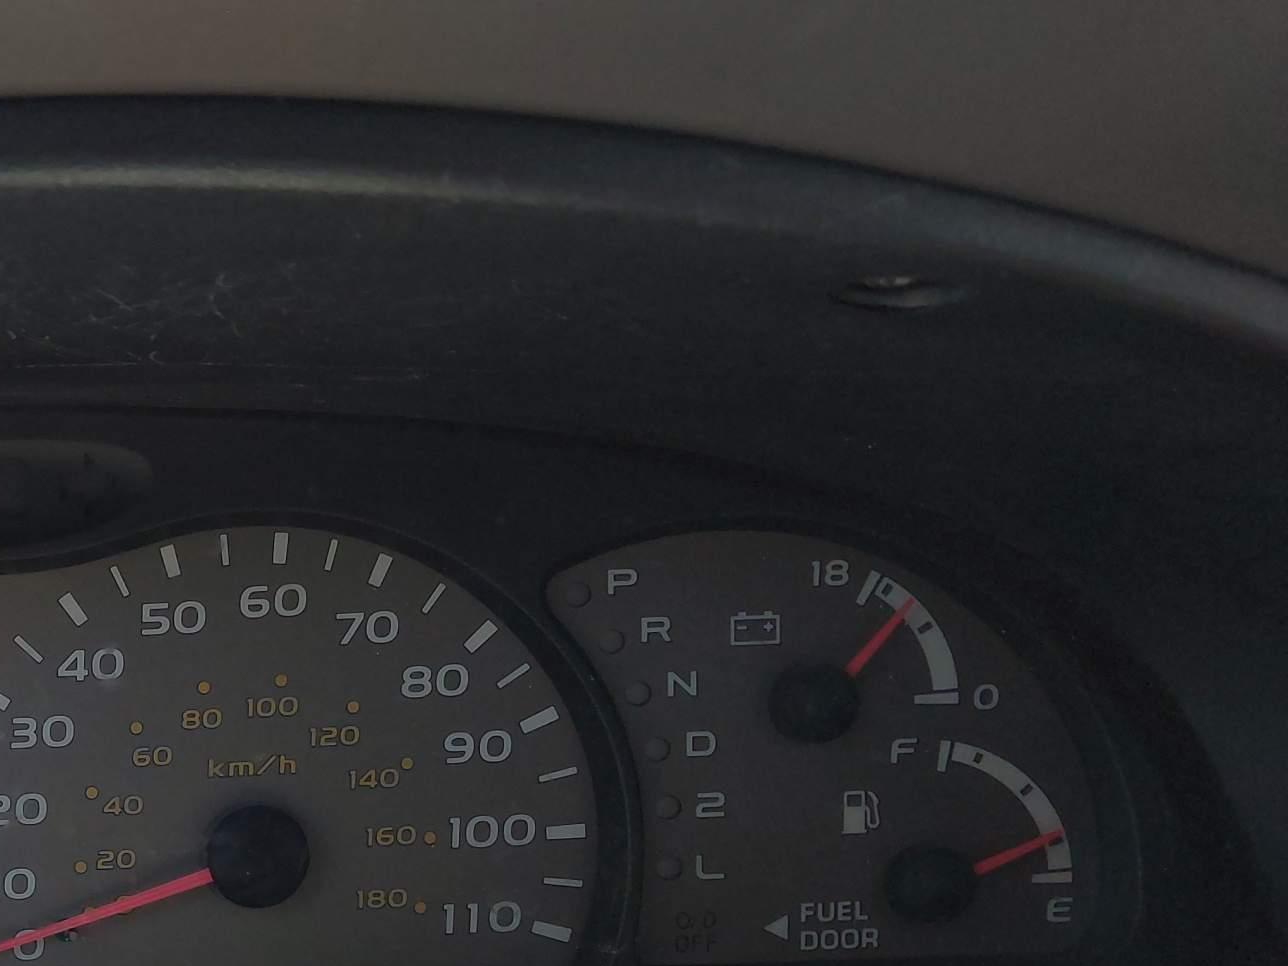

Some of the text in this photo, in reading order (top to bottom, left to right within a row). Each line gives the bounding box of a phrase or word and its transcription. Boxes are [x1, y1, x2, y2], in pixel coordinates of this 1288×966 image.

[607, 568, 639, 595] P
[811, 559, 850, 586] 18
[238, 582, 308, 619] 60
[139, 599, 207, 637] 50
[334, 609, 400, 646] 70
[640, 615, 672, 643] R
[56, 648, 126, 683] 40
[399, 662, 470, 700] 80
[666, 669, 698, 698] N
[181, 708, 223, 730] 80
[245, 696, 300, 718] 100
[10, 714, 76, 750] 30
[308, 725, 361, 747] 120
[685, 730, 718, 758] D
[131, 746, 174, 768] 60
[441, 729, 513, 766] 90
[889, 737, 918, 764] F
[206, 755, 297, 778] km/h
[348, 768, 400, 790] 140
[102, 795, 145, 817] 40
[695, 791, 726, 819] 2
[365, 825, 416, 847] 160
[448, 813, 537, 850] 100
[95, 849, 137, 871] 20
[695, 854, 726, 881] L
[356, 888, 408, 910] 180
[800, 900, 870, 923] FUEL
[1046, 897, 1073, 923] E
[442, 900, 523, 936] 110
[13, 929, 45, 961] 0
[800, 928, 880, 951] DOOR
